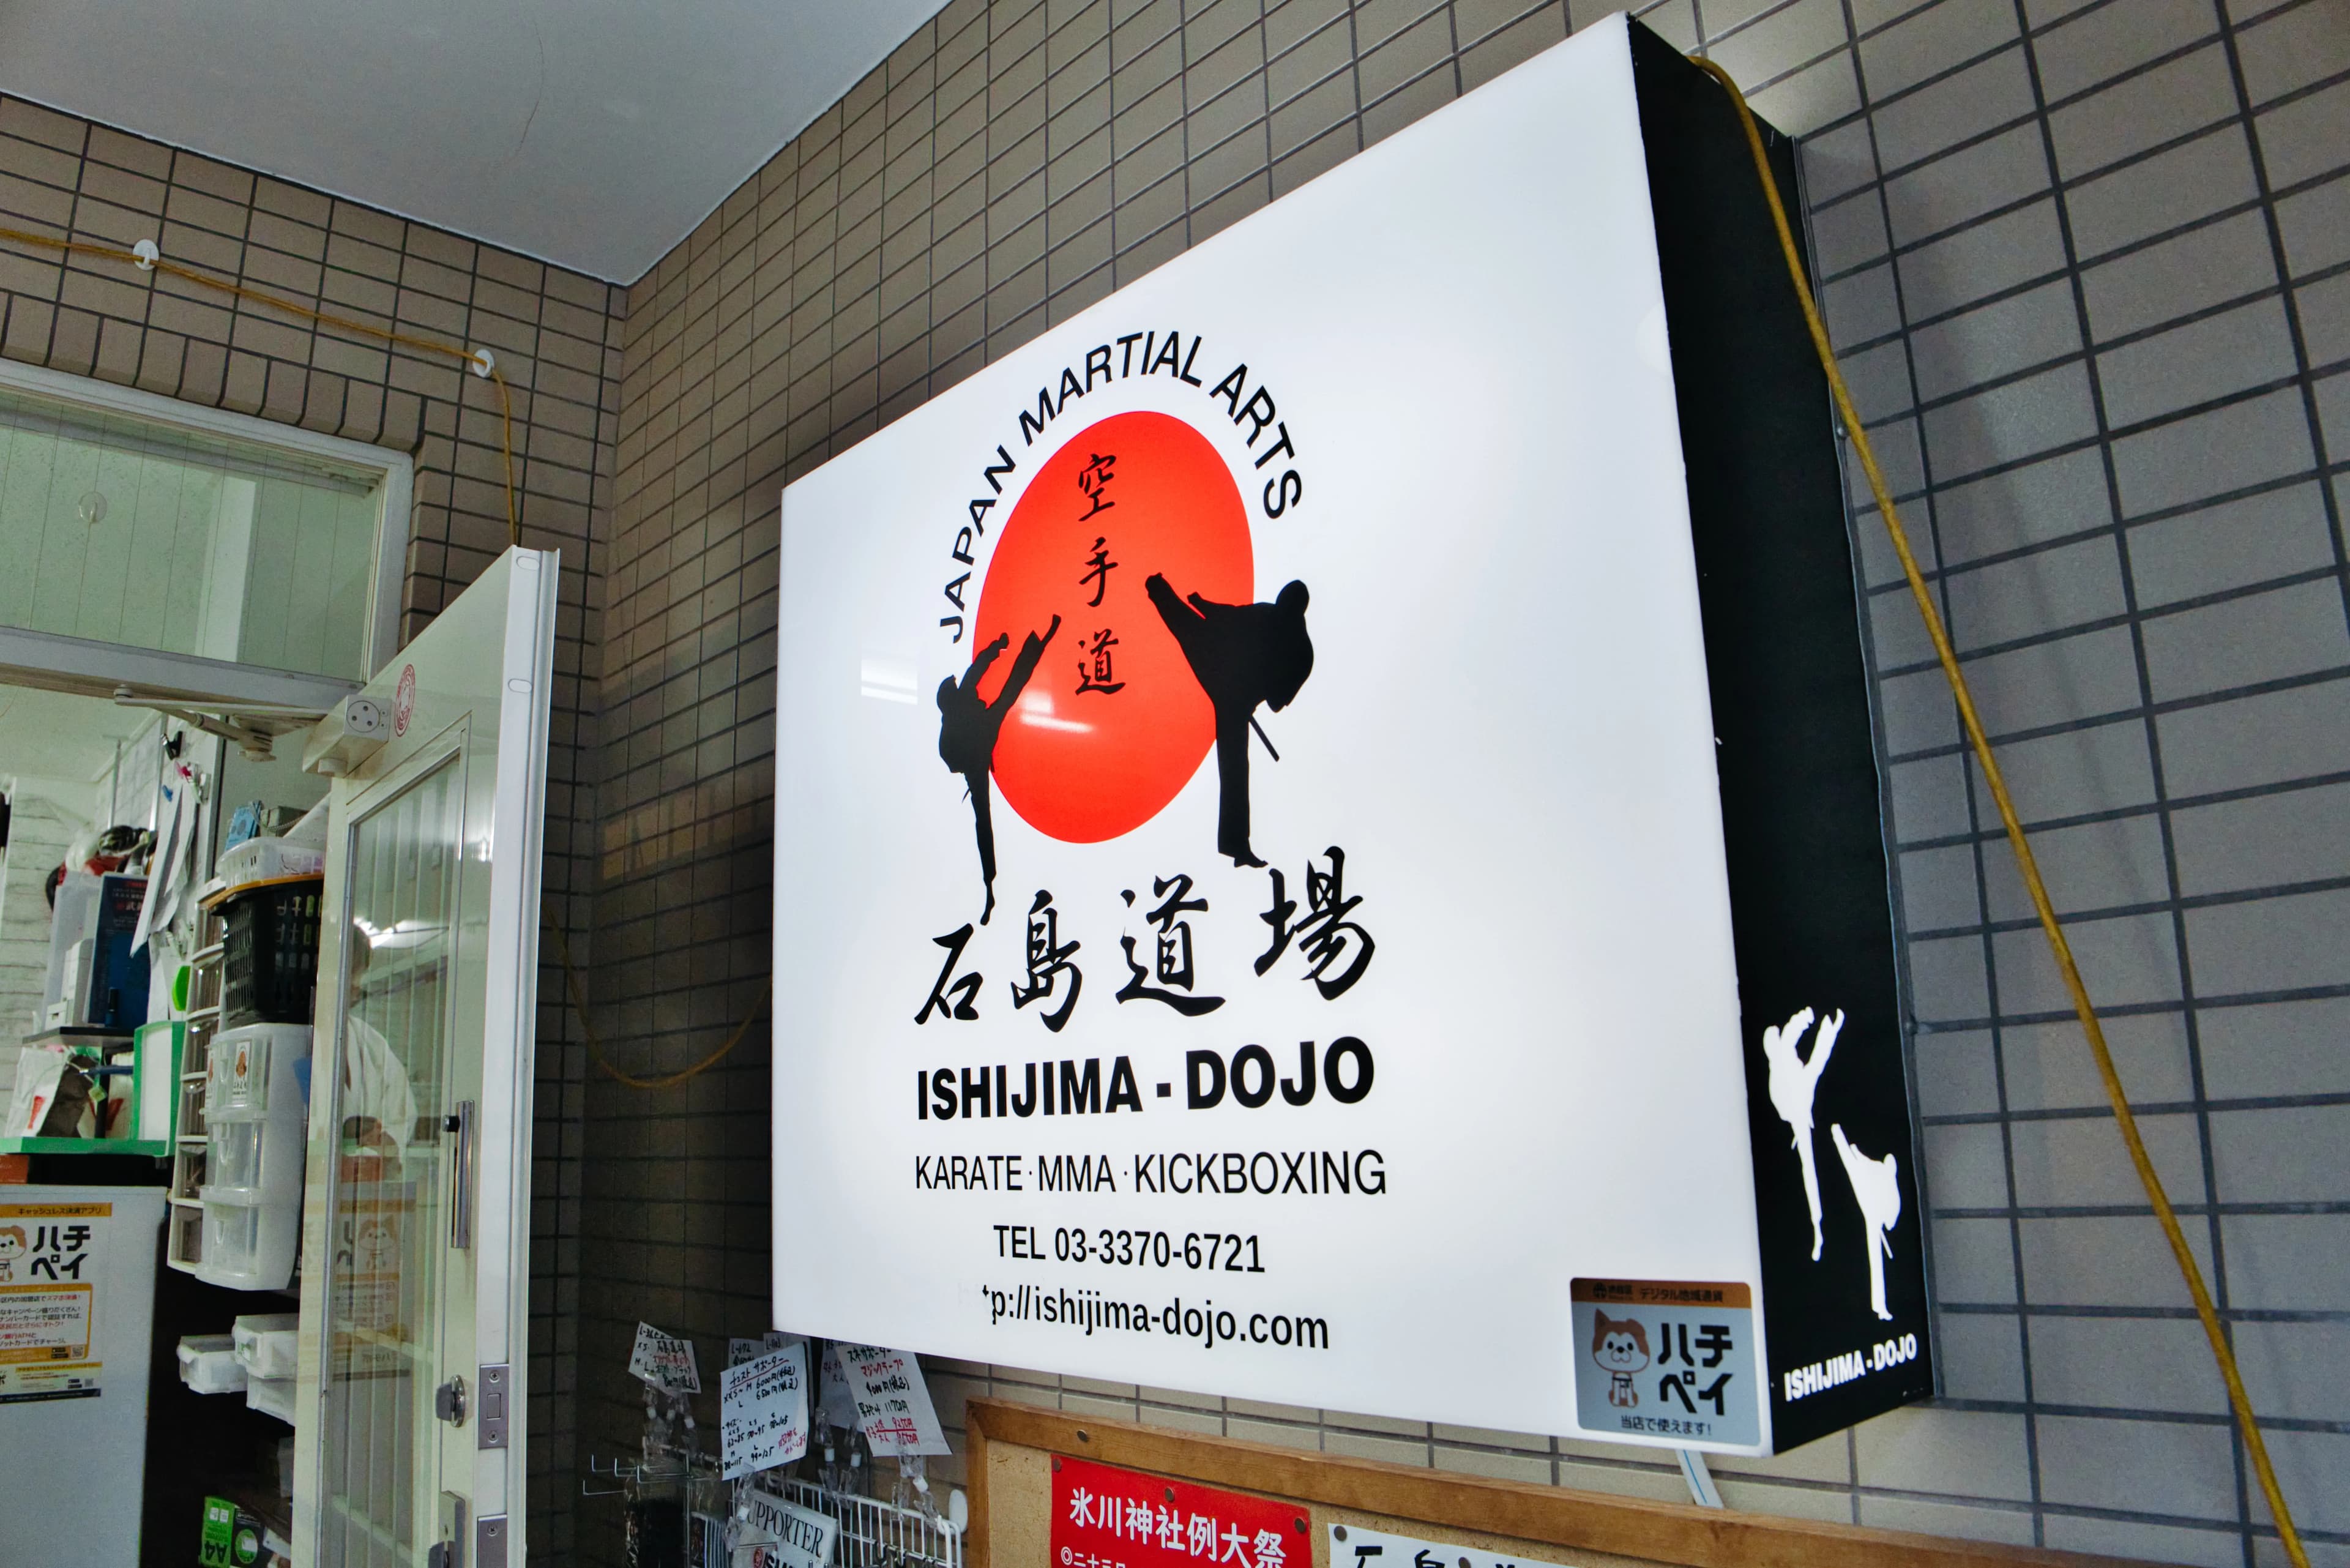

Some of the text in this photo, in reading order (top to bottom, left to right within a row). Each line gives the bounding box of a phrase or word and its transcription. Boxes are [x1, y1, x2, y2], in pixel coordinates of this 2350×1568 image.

[940, 330, 1302, 643] JAPAN MARTIAL ARTS
[1075, 454, 1126, 696] 空手道
[914, 845, 1376, 1033] 石島道場
[916, 1149, 1387, 1195] KARATE MMA KICKBOXING
[32, 1226, 90, 1252] ハチ
[993, 1225, 1266, 1273] TEL 03-3370-6721
[31, 1253, 88, 1280] ペイ
[982, 1284, 1329, 1349] p://ishijima-dojo.com
[1658, 1323, 1733, 1368] ハチ
[1659, 1370, 1733, 1416] ペイ
[747, 1499, 824, 1558] UPPORTER
[1069, 1487, 1286, 1568] 氷川神社例大祭
